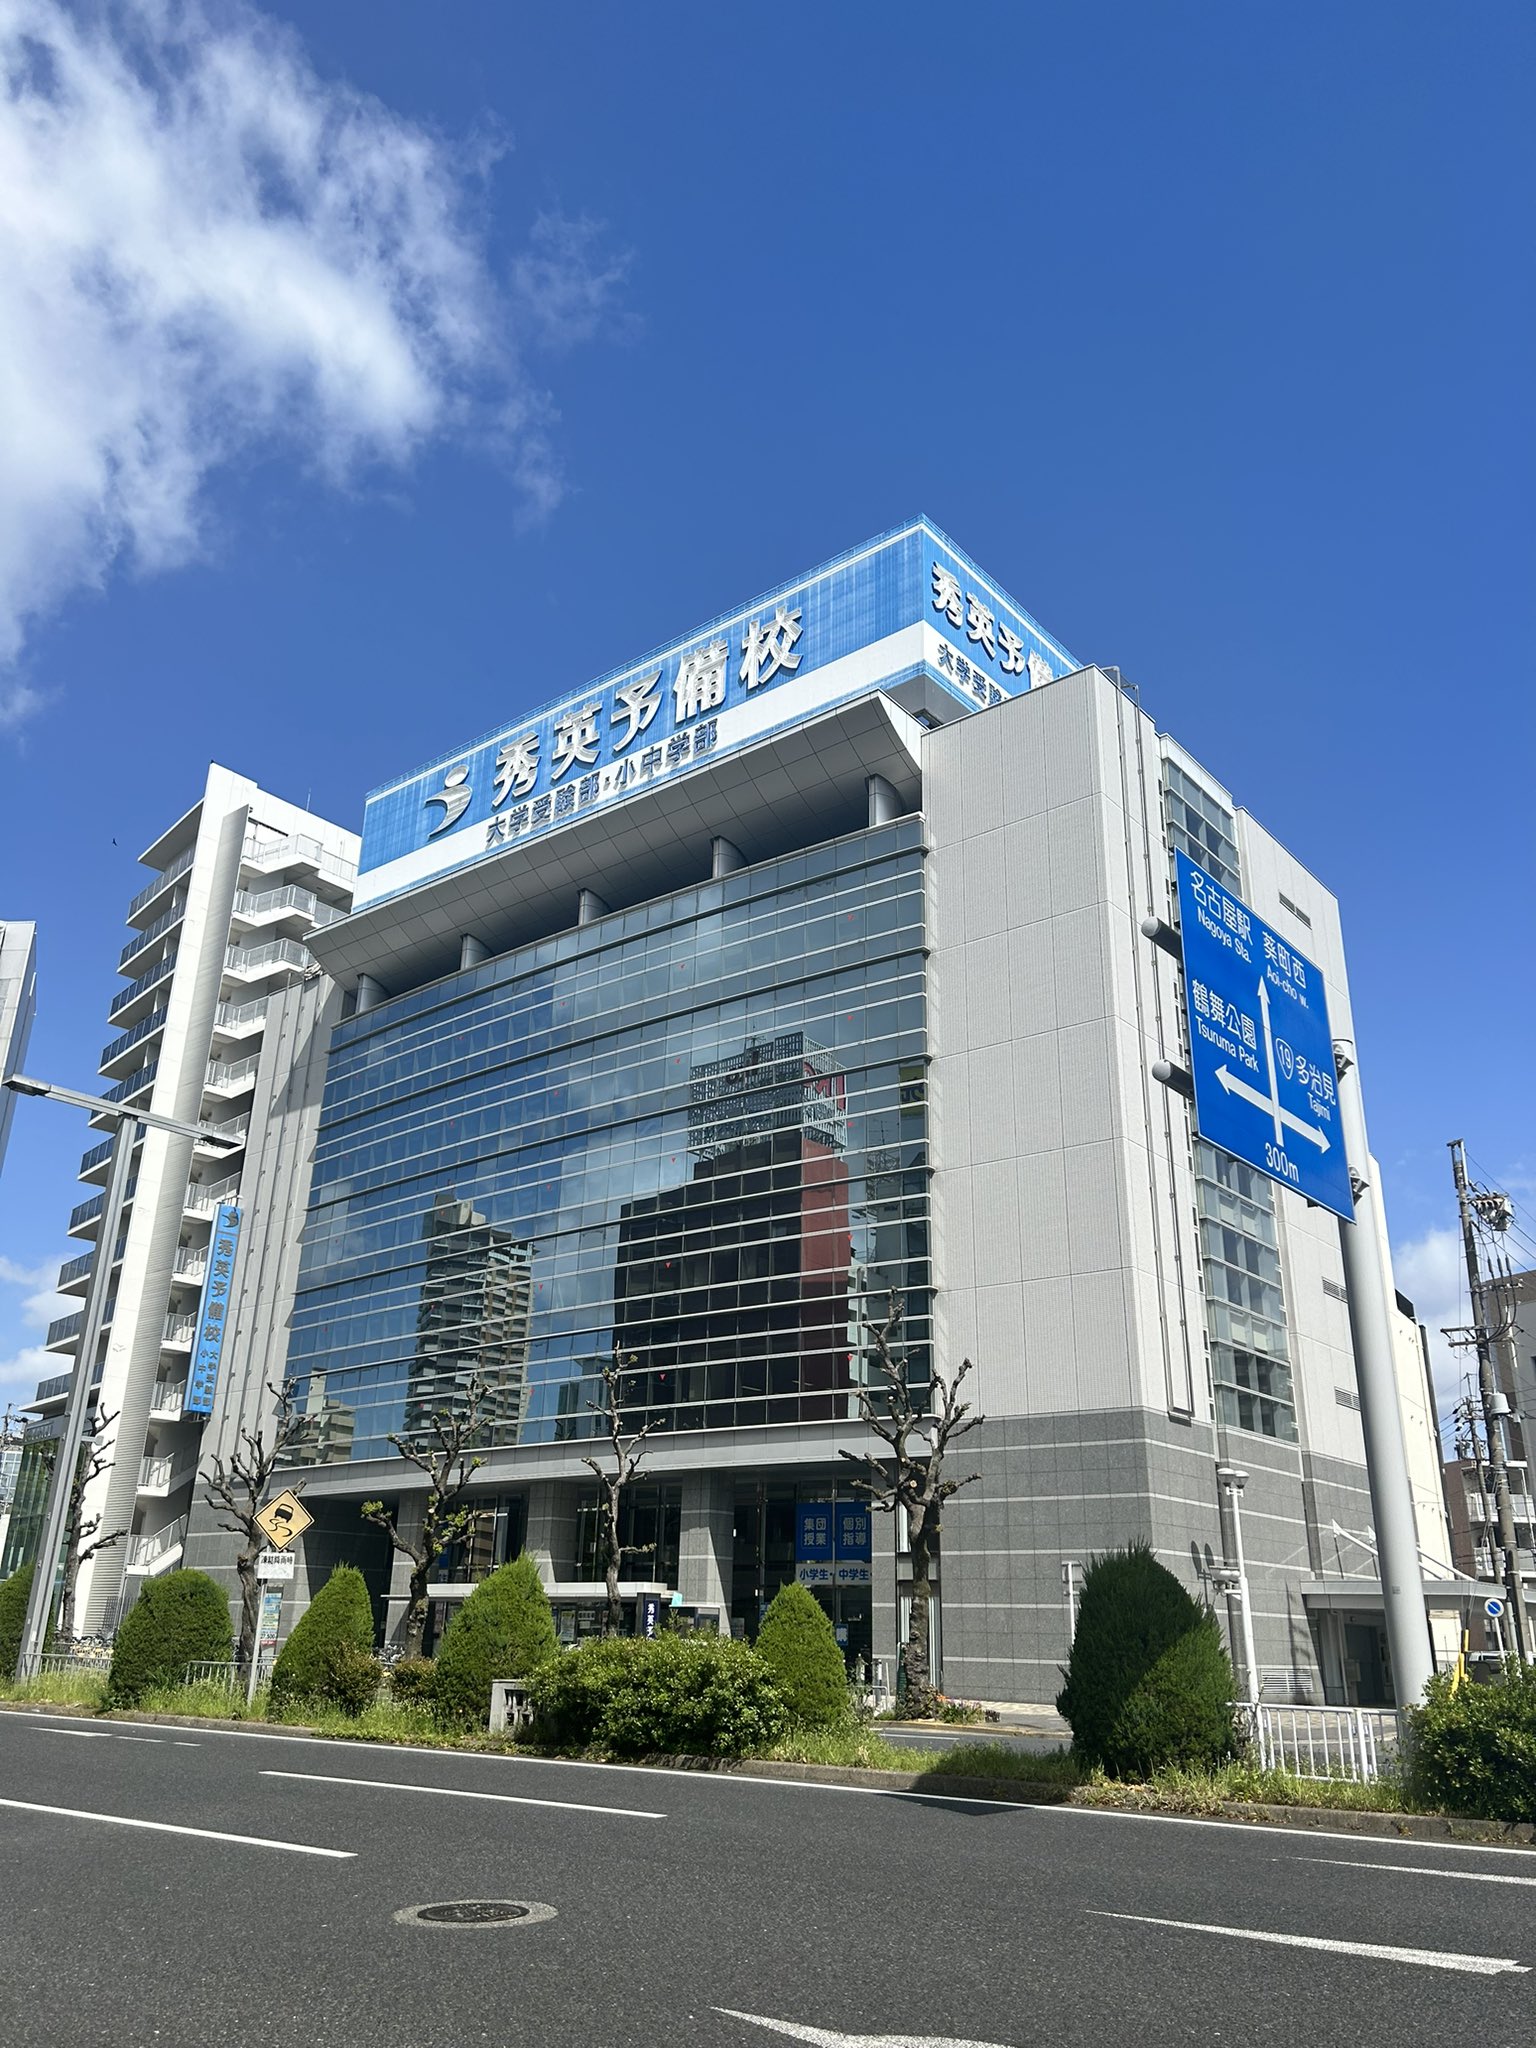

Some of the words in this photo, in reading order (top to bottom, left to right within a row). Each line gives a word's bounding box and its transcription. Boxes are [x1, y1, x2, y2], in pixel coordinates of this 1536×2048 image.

[491, 604, 804, 807] 秀英予備校
[485, 718, 718, 845] 大学受験部・小中学部
[1190, 871, 1253, 946] 名古屋駅
[1197, 905, 1233, 948] Nagoya
[1234, 937, 1252, 963] Sta.
[1262, 930, 1307, 989] 葵町西
[1267, 964, 1298, 1000] Aoi-cho
[1191, 978, 1257, 1051] 鶴舞公園
[1195, 1014, 1237, 1058] Tsuruma
[1238, 1044, 1260, 1073] Park
[1279, 1043, 1292, 1070] 19
[1295, 1054, 1337, 1106] 多治見
[1307, 1091, 1332, 1121] Tajimi
[1264, 1141, 1300, 1184] 300m
[203, 1238, 234, 1344] 秀英予備校
[803, 1517, 828, 1531] 集団
[803, 1532, 828, 1546] 授業
[842, 1516, 867, 1531] 個別
[842, 1532, 867, 1546] 指導
